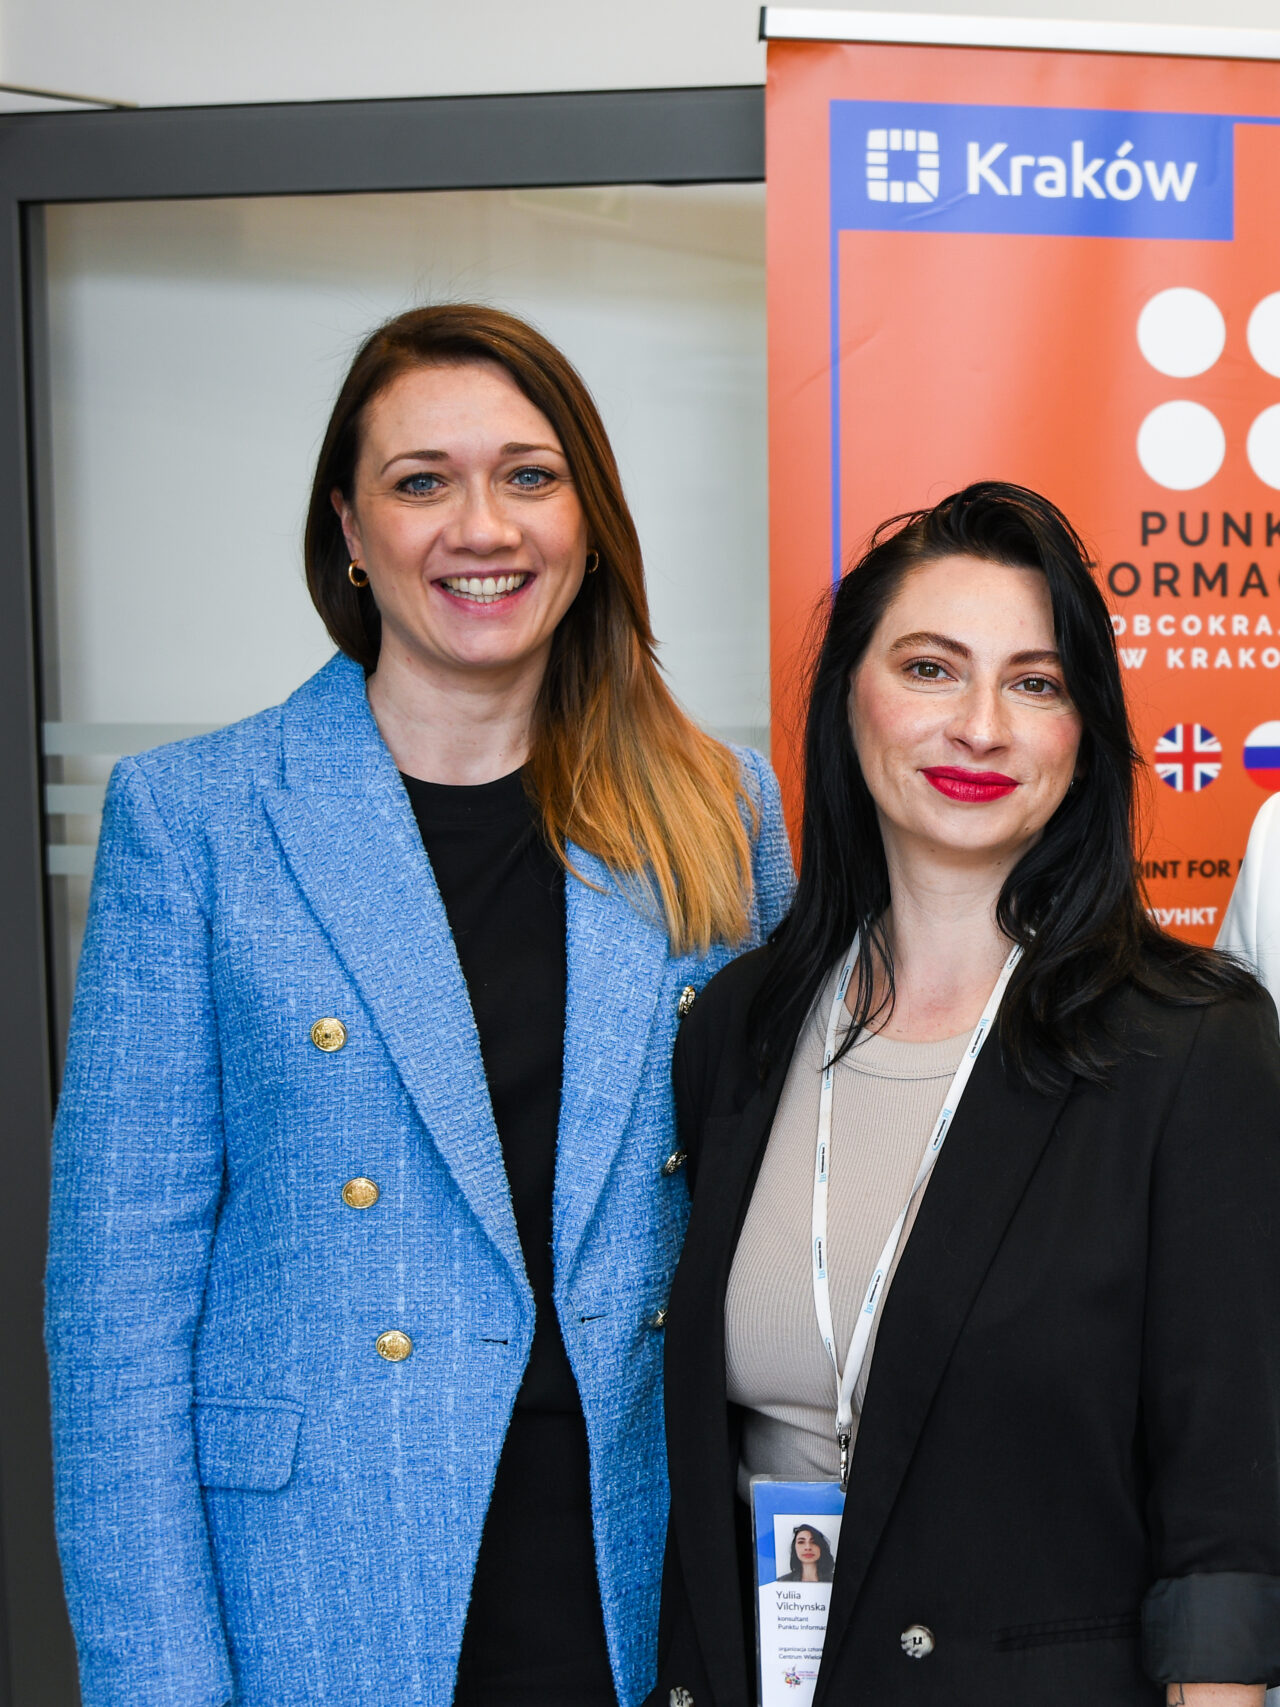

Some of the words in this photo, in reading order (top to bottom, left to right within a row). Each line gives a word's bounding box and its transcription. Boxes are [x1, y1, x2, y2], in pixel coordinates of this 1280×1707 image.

[967, 140, 1197, 202] Kraków
[1119, 648, 1147, 669] W
[1187, 859, 1231, 879] FOR
[776, 1590, 801, 1600] Yuliia
[776, 1602, 826, 1612] Vilchynska
